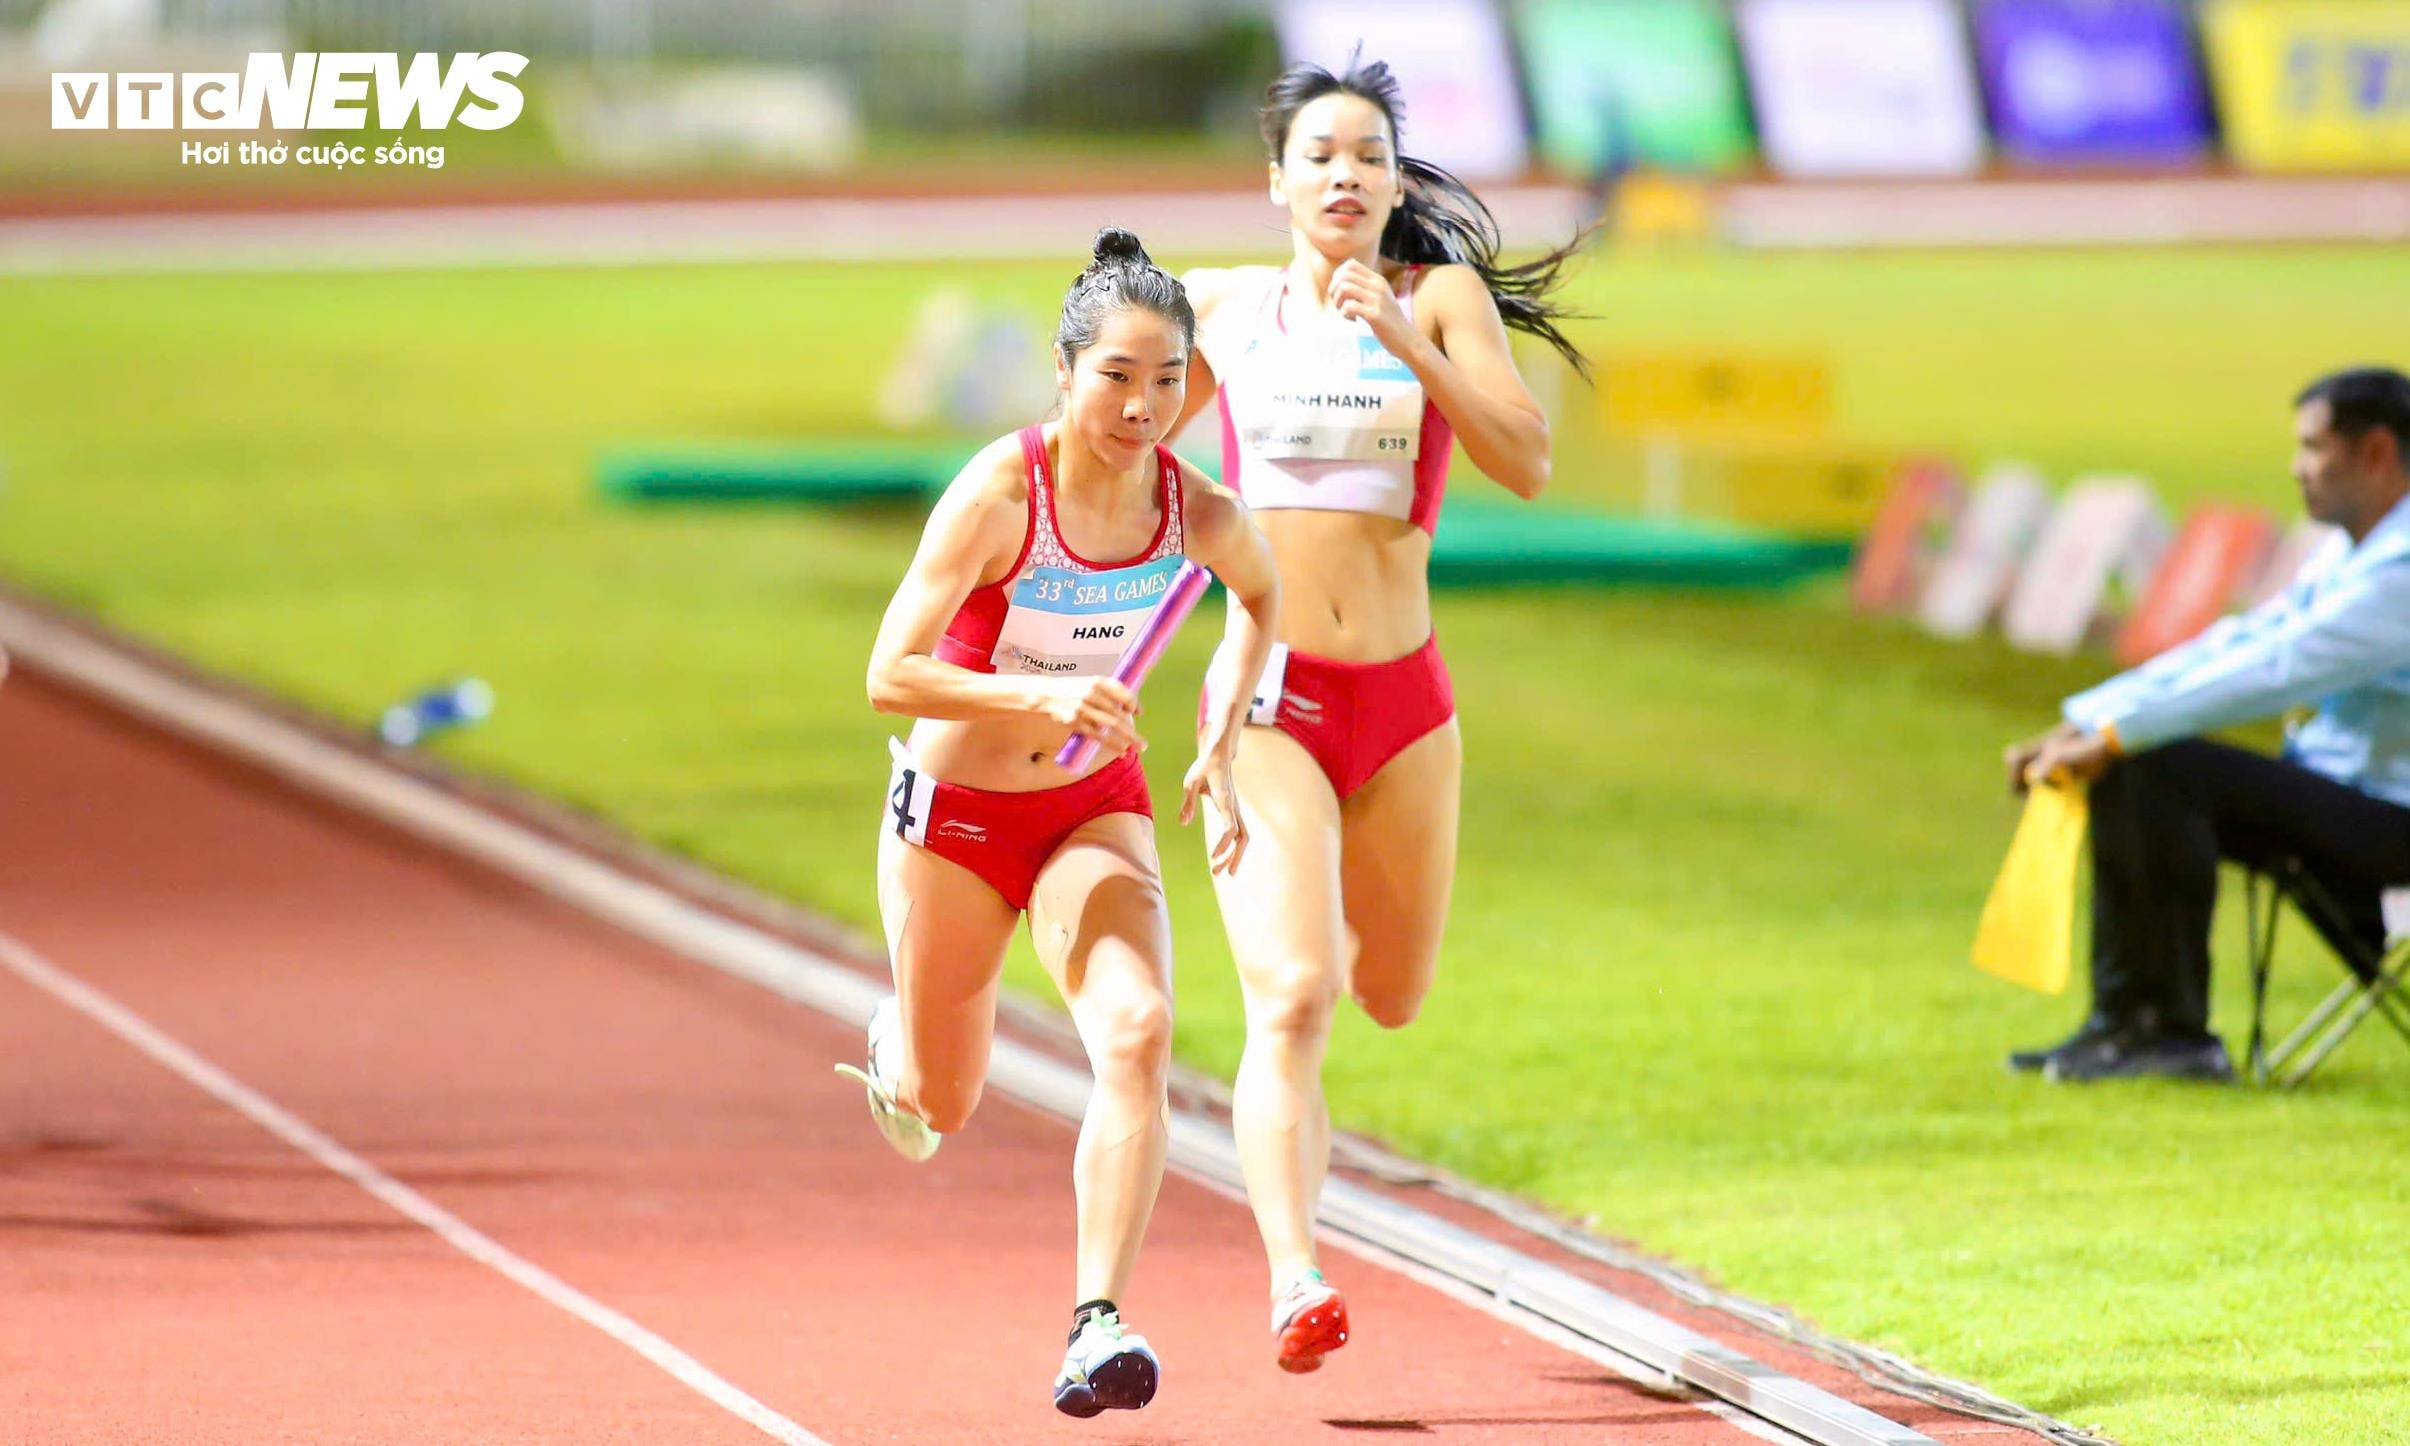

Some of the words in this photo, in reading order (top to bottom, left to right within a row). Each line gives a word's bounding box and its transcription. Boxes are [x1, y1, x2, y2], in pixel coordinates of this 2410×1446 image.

[1327, 394, 1382, 409] HANH
[1378, 437, 1407, 450] 639
[1035, 577, 1075, 602] 33rd
[1073, 586, 1108, 606] SEA
[1114, 571, 1168, 601] GAMES
[1072, 625, 1125, 640] HANG
[1023, 654, 1077, 671] THAILAND
[892, 768, 917, 841] 4
[937, 829, 987, 842] LI-NING
